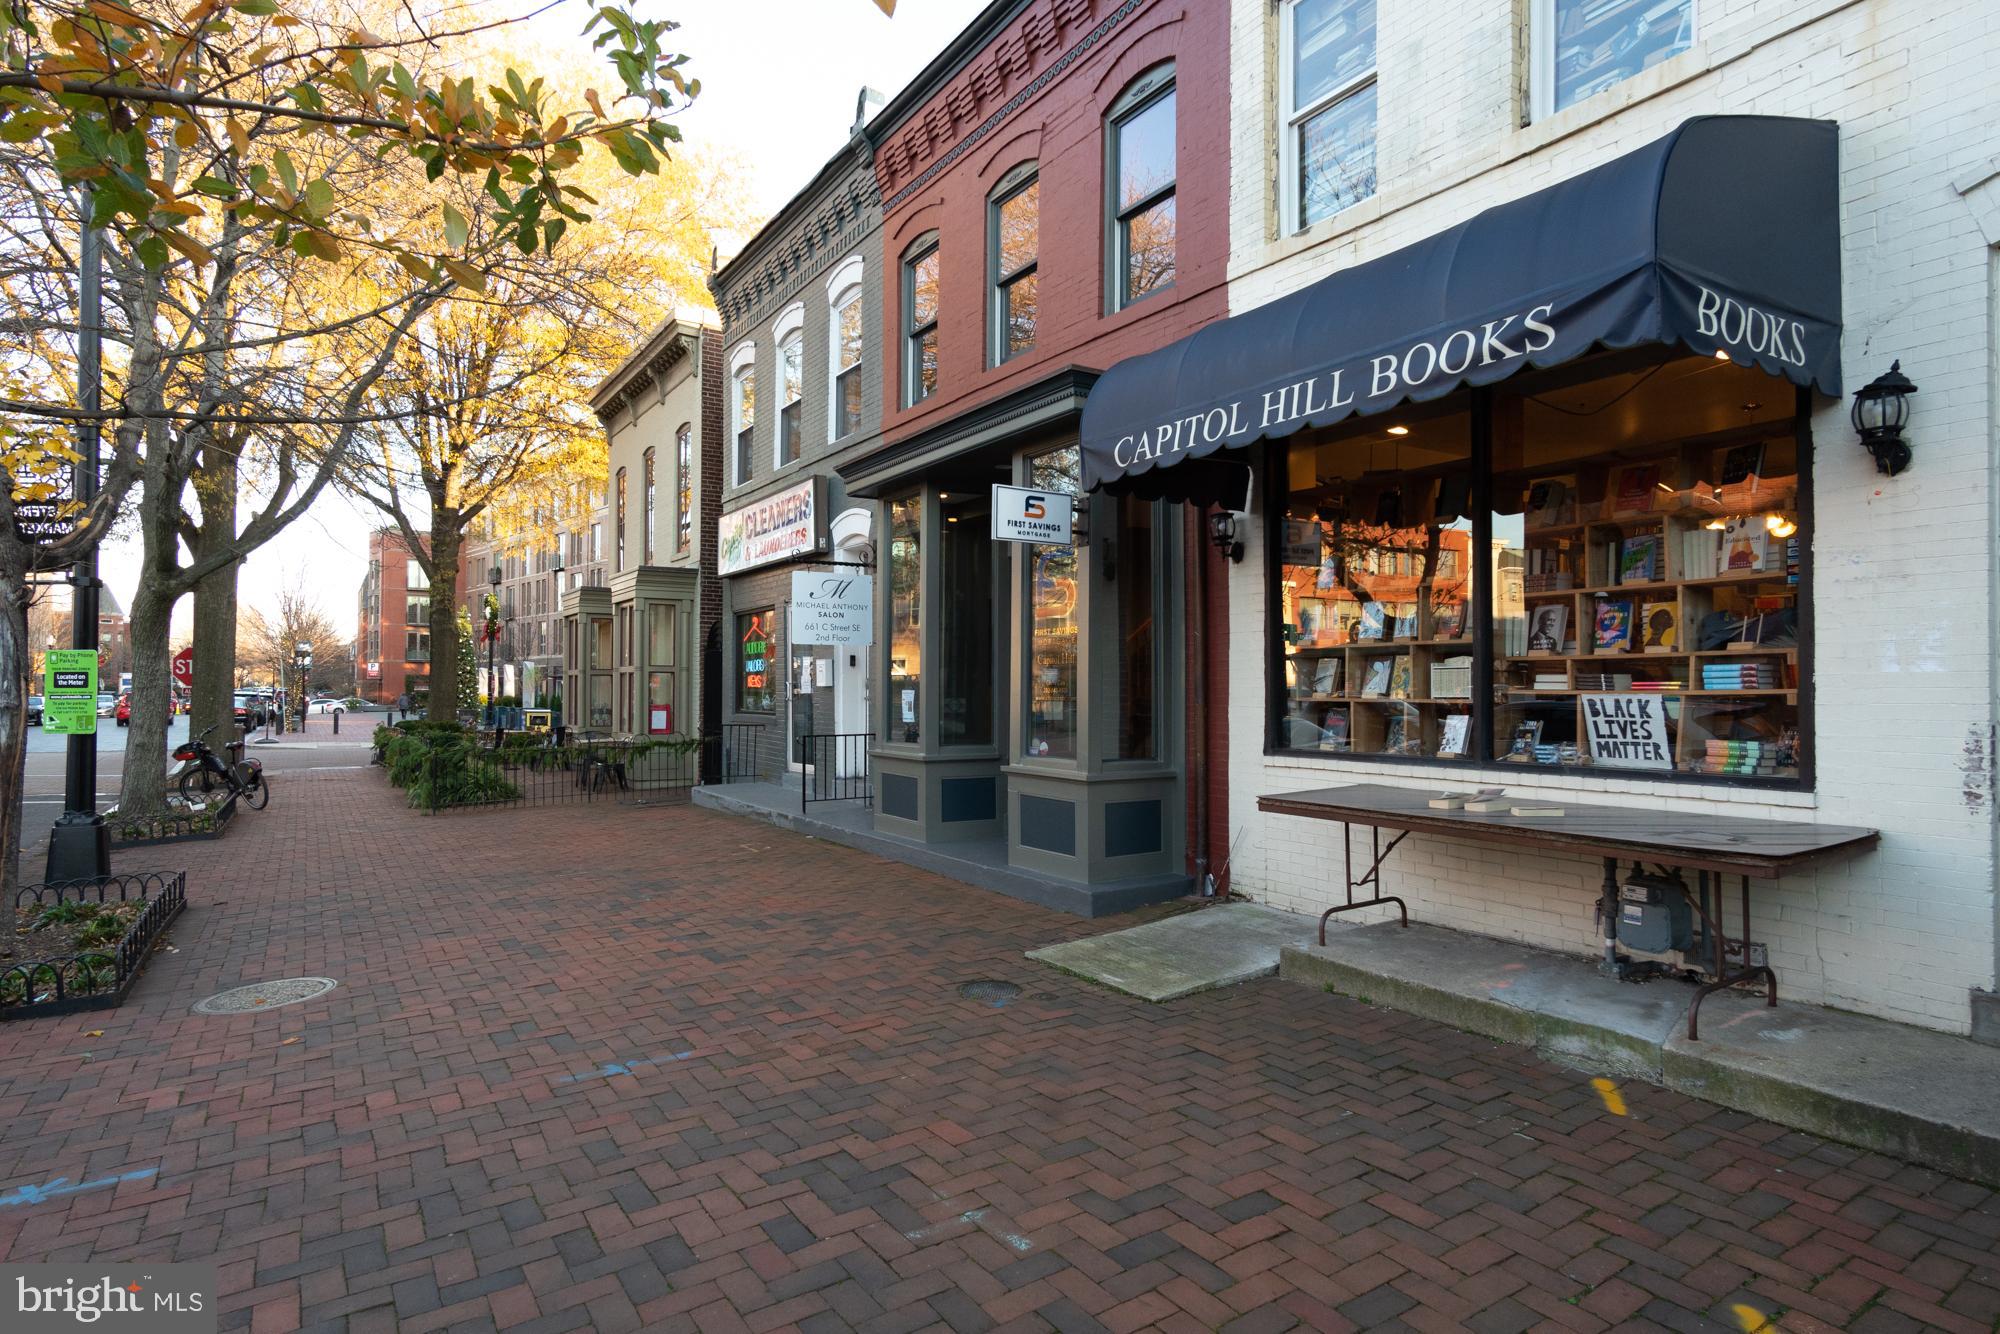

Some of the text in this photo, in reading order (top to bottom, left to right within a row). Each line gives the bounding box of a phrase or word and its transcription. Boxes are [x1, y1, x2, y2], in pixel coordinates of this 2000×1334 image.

[1696, 286, 1806, 366] BOOKS
[1113, 302, 1557, 467] CAPITOL HILL BOOKS
[746, 490, 812, 540] CLEANERS
[1007, 520, 1061, 532] FIRST SAVINGS
[1018, 530, 1051, 538] MORTGAGE
[809, 579, 854, 599] M
[832, 603, 869, 611] ANTHONY
[804, 623, 861, 632] 661 C Street SE
[1052, 626, 1078, 635] SAVINGS
[832, 634, 850, 642] Floor
[1586, 698, 1653, 719] BLACK
[1592, 720, 1653, 740] LIVES
[1596, 741, 1665, 760] MATTER
